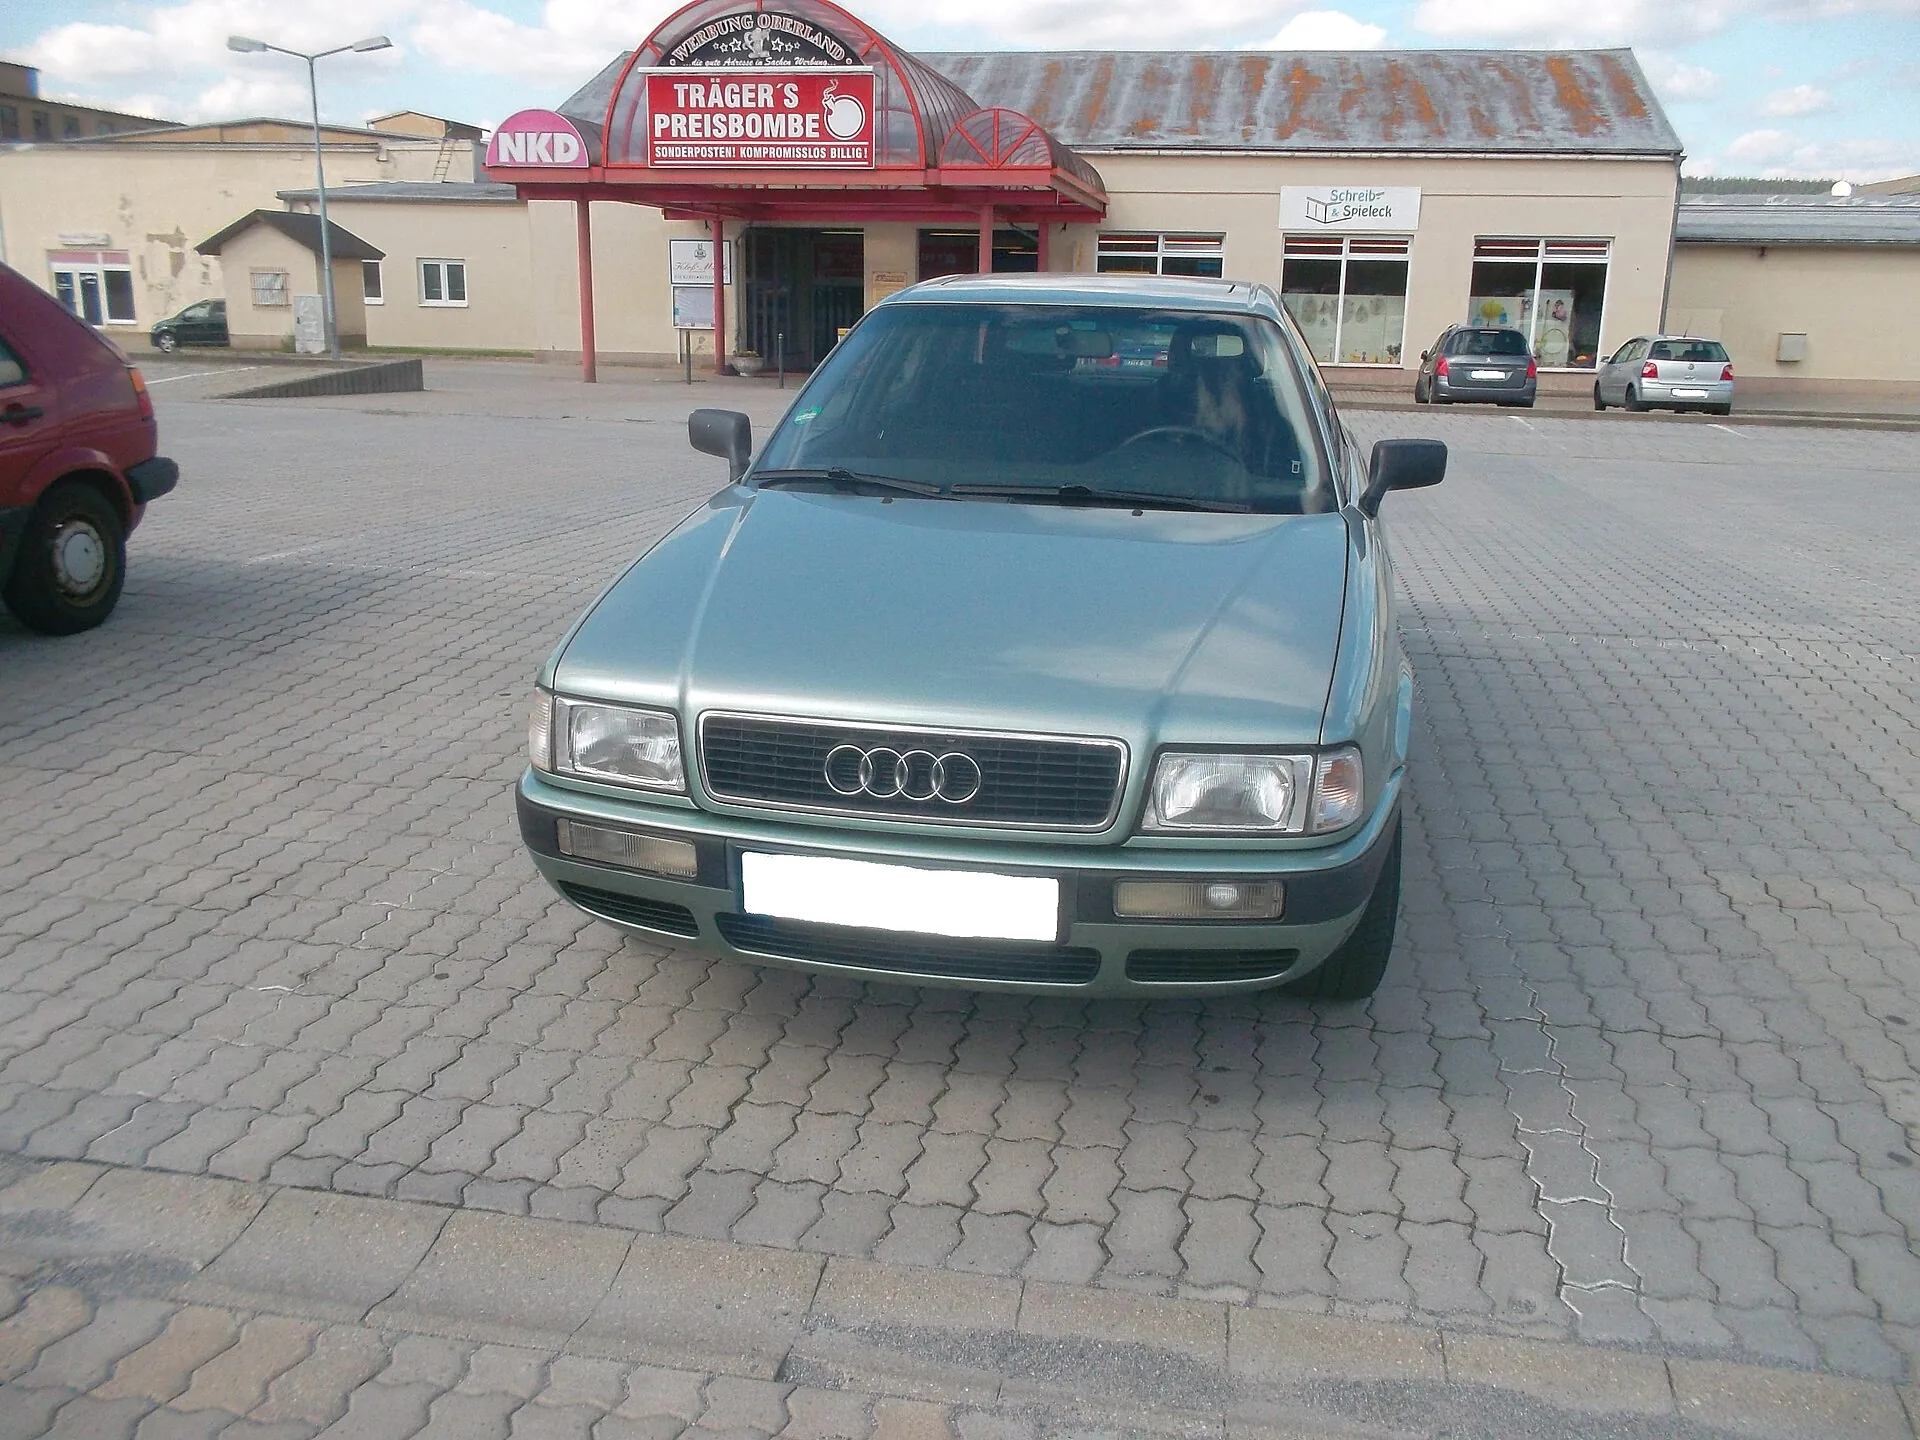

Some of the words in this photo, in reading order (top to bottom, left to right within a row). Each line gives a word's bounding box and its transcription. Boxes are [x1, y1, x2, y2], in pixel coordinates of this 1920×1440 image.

[671, 14, 754, 62] WERBUNG
[757, 14, 846, 61] OBERLAND
[723, 57, 753, 66] Adresse
[755, 58, 762, 66] in
[764, 56, 792, 66] Sachen
[653, 113, 820, 138] PREISBOMBE
[497, 131, 580, 163] NKD
[654, 146, 736, 158] SONDERPOSTEN!
[740, 146, 827, 159] KOMPROMISSLOS
[830, 147, 868, 159] BILLIG!
[1331, 208, 1340, 217] &
[1343, 204, 1392, 218] Spieleck
